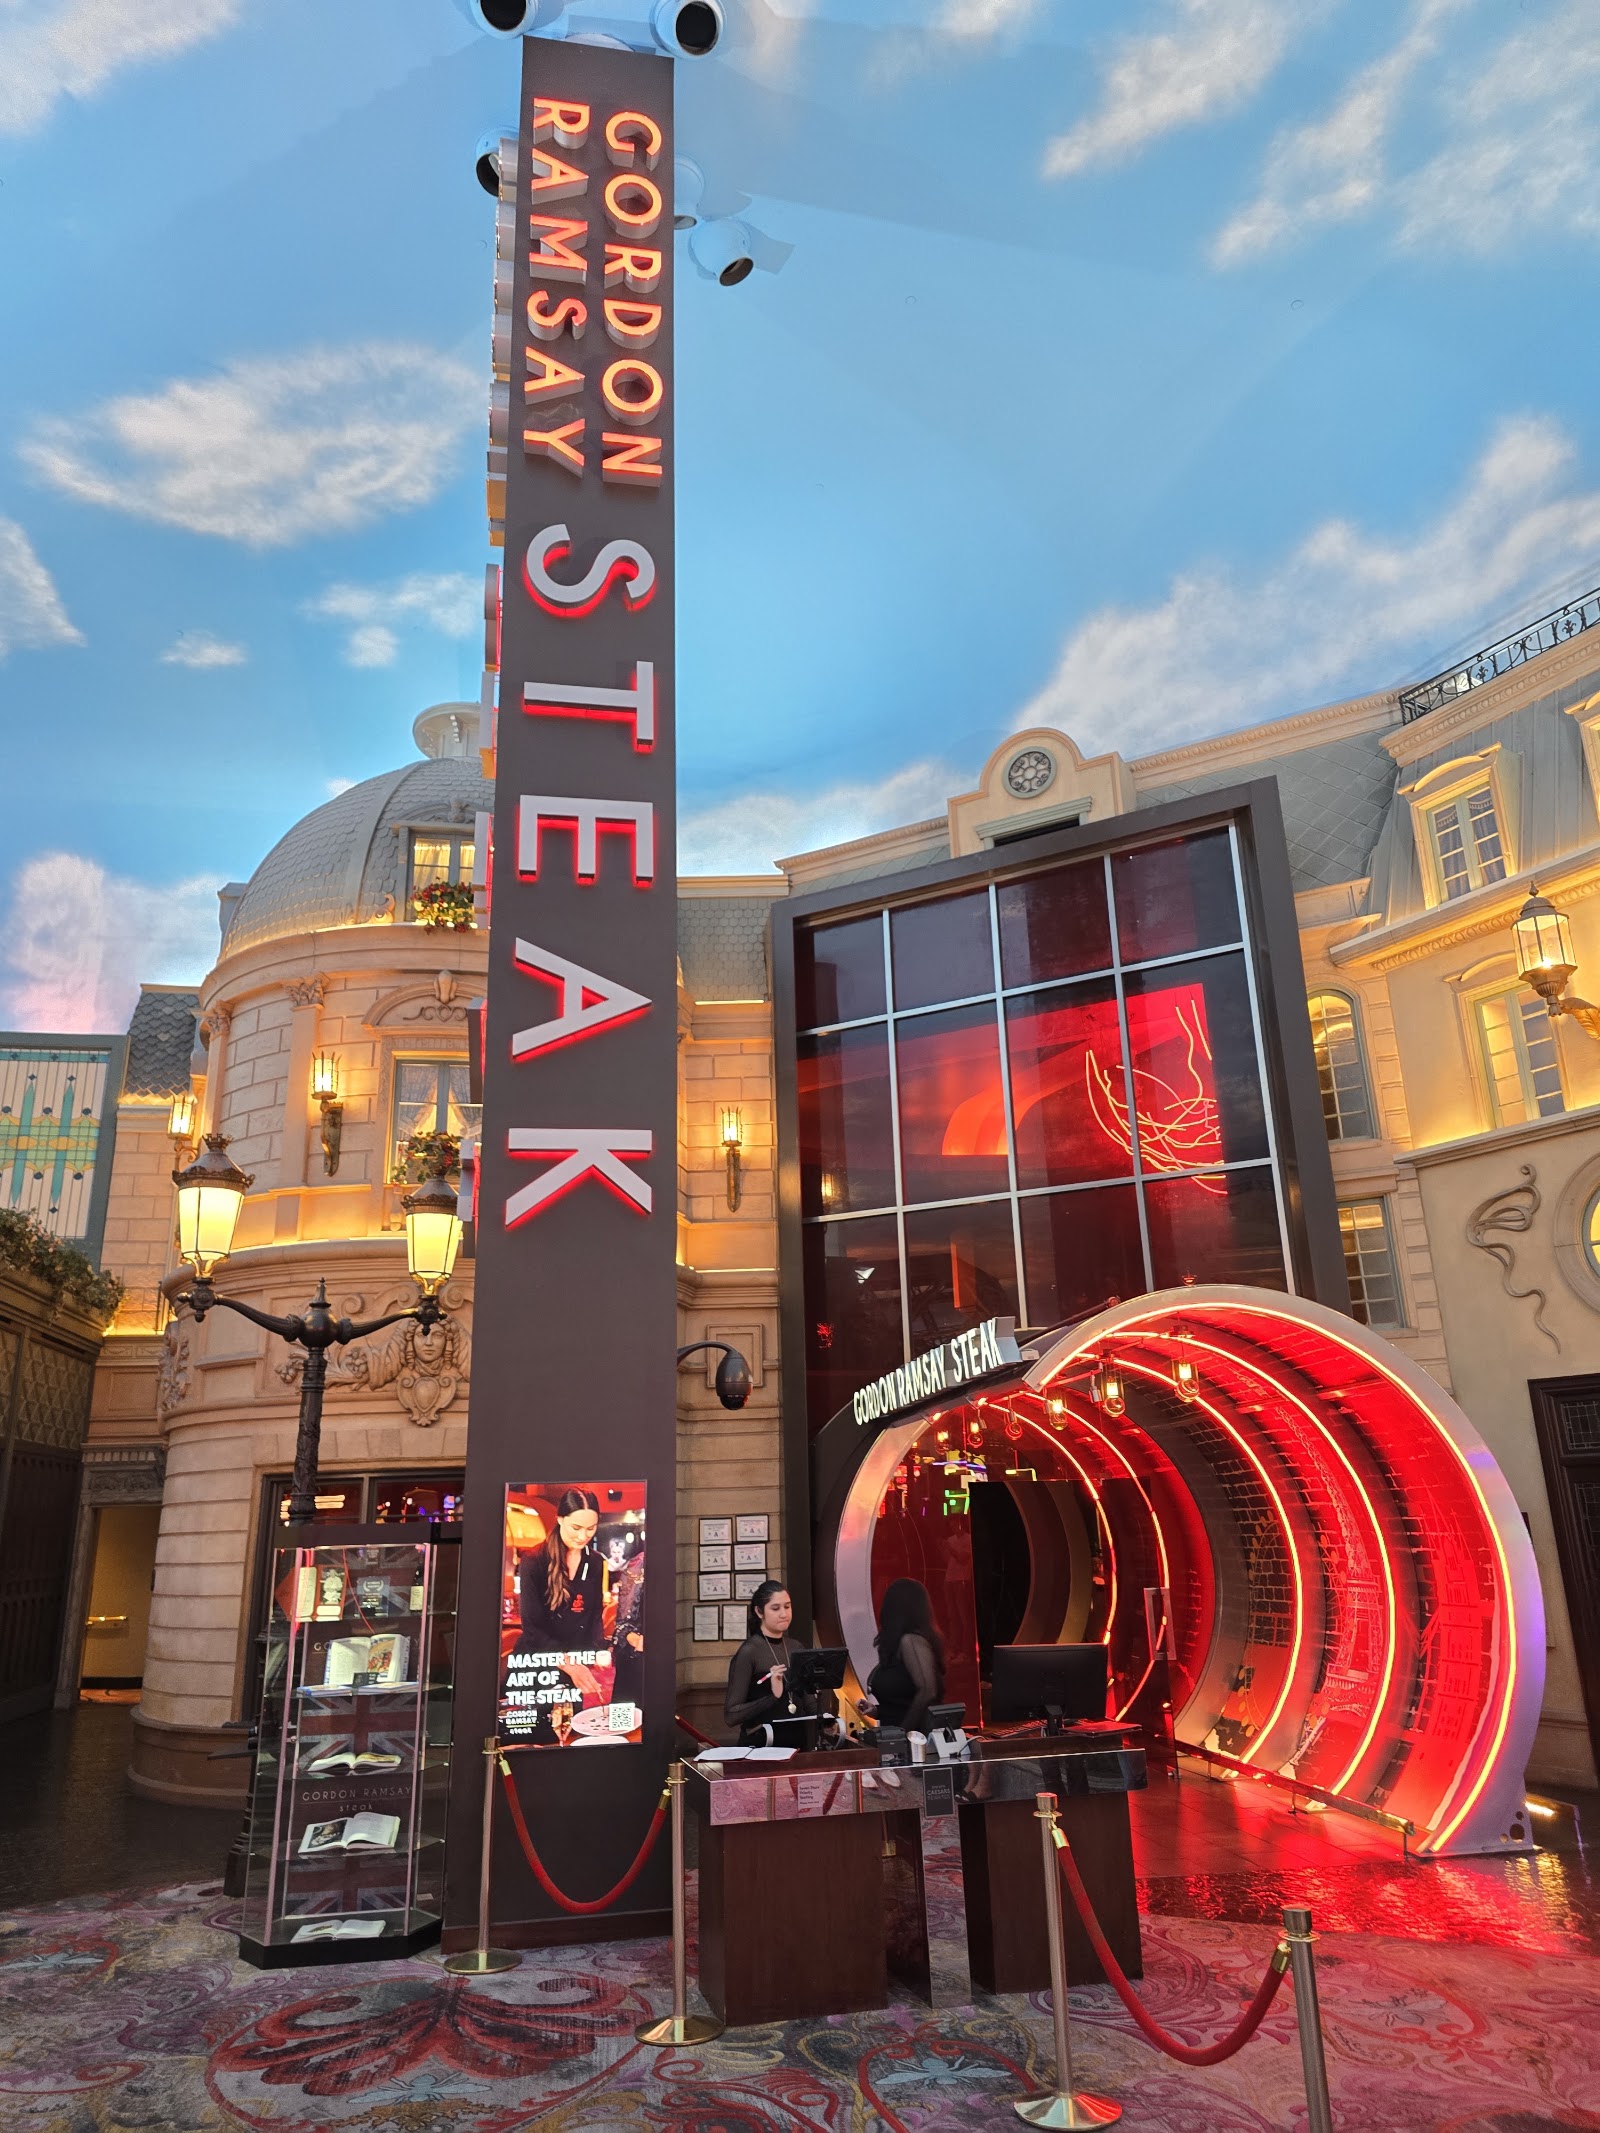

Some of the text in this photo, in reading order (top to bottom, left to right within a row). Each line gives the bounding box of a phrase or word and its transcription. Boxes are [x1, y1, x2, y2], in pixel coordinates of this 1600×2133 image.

[522, 97, 590, 480] RAMSAY
[602, 111, 663, 487] GORDON
[504, 523, 656, 1227] STEAK
[853, 1316, 1007, 1426] GORDON RAMSAY STEAK
[507, 1650, 596, 1668] MASTER THE
[506, 1670, 560, 1687] ART OF
[505, 1688, 583, 1706] THE STEAK
[302, 1786, 412, 1801] GORDON RAMSAY
[926, 1788, 951, 1796] CAESARS
[339, 1802, 374, 1812] steak
